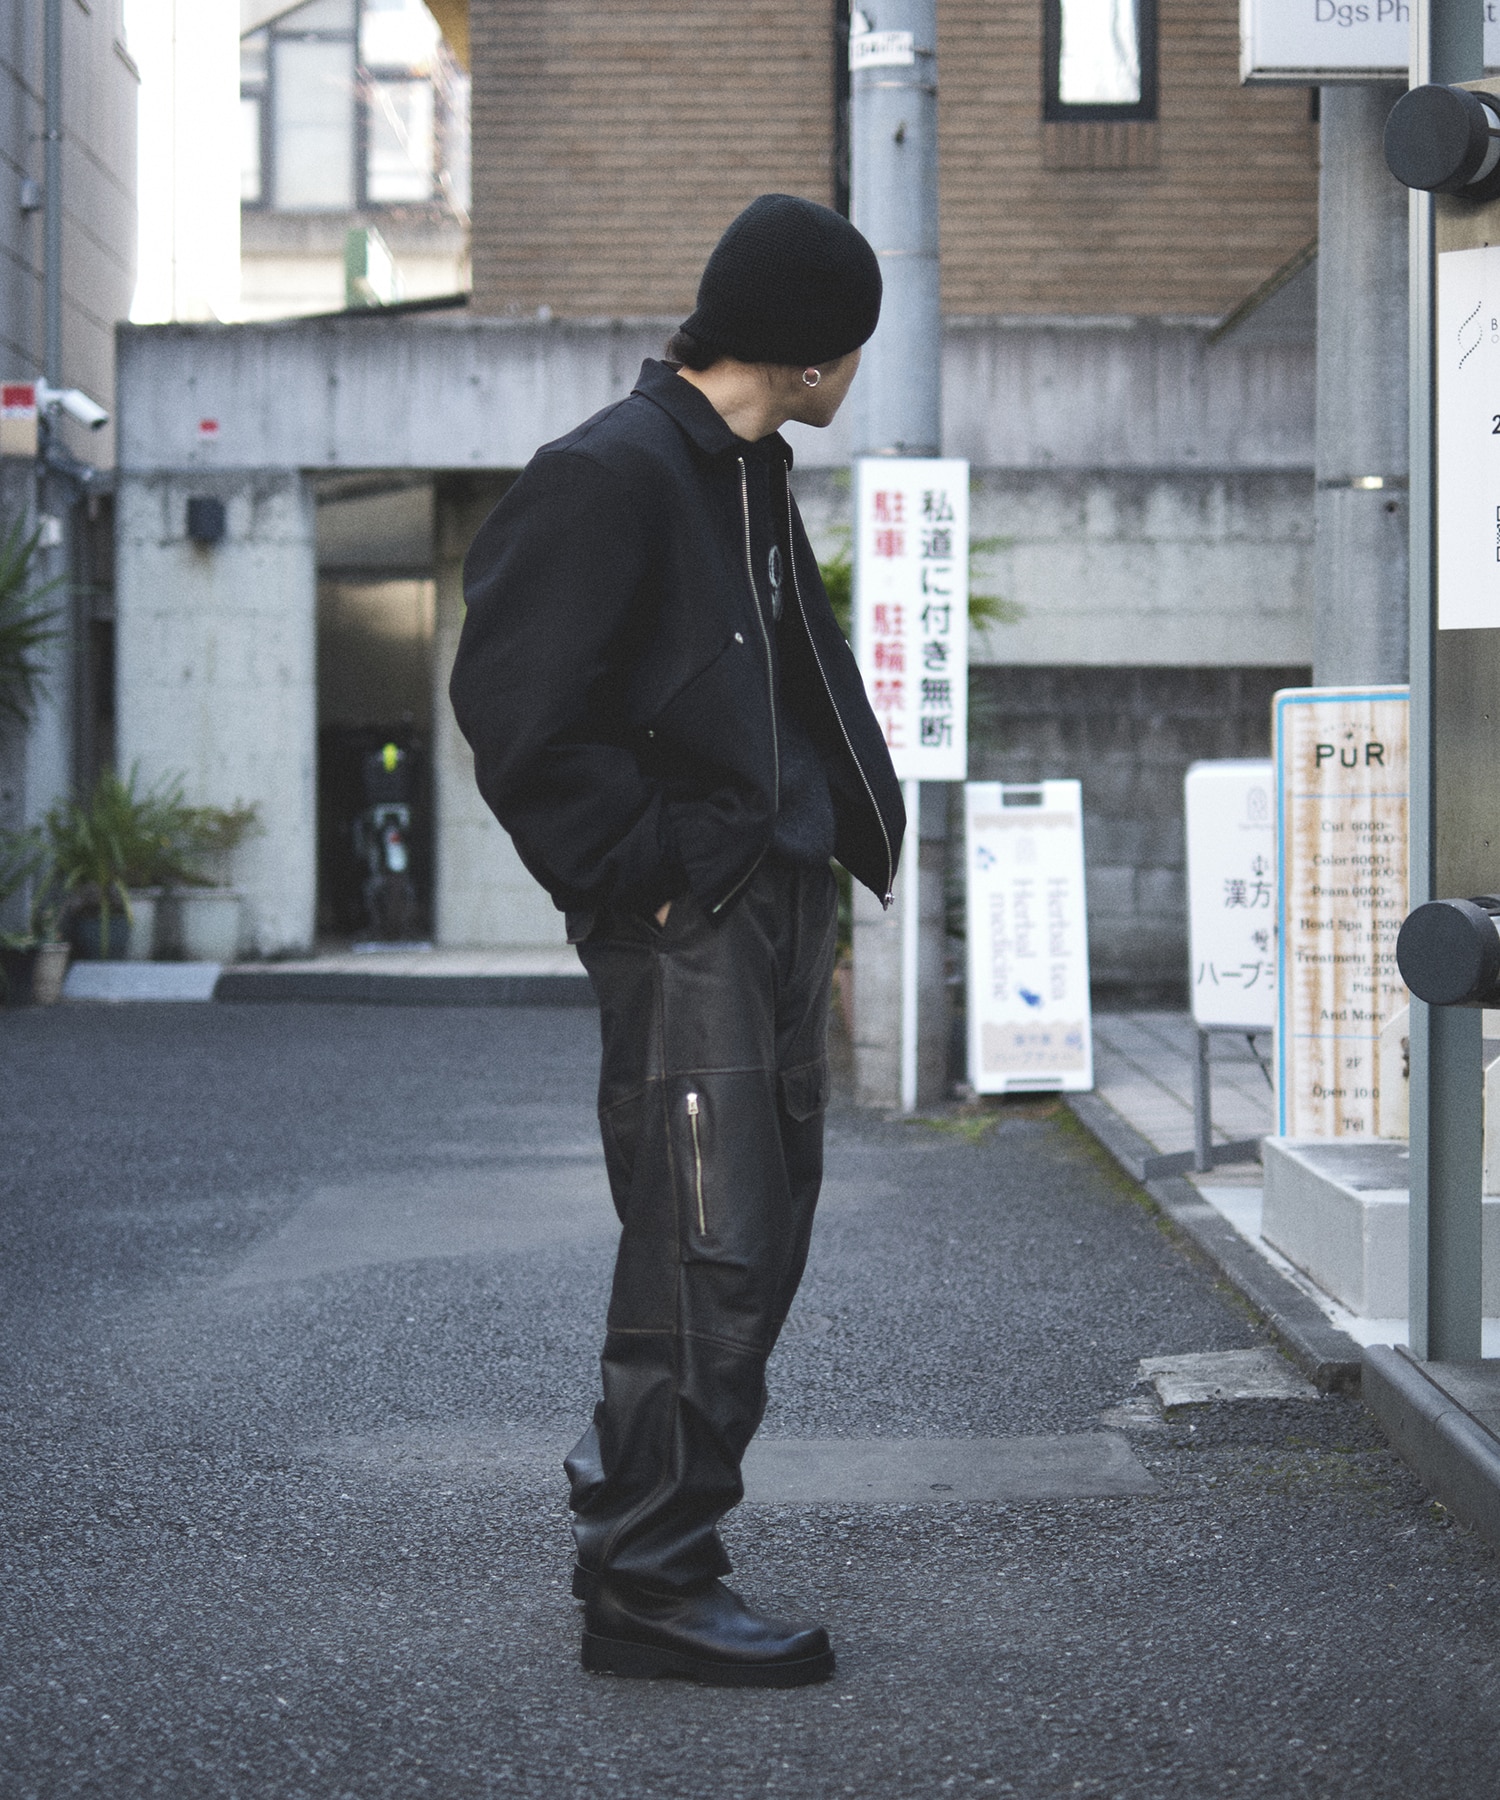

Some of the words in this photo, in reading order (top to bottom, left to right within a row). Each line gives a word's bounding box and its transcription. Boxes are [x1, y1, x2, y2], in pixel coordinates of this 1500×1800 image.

[1315, 0, 1370, 27] Dgs
[920, 490, 955, 748] 私道に付き無断
[1321, 820, 1344, 832] Cut
[1312, 854, 1348, 866] Color
[1223, 879, 1273, 909] 漢方
[1300, 919, 1333, 930] Head
[1337, 919, 1362, 932] Spa
[1296, 951, 1366, 963] Treatment
[1373, 953, 1397, 963] 200
[1320, 1009, 1347, 1021] And
[1352, 1009, 1386, 1021] More
[1345, 1057, 1362, 1069] 2F
[1312, 1083, 1347, 1100] Open
[1342, 1118, 1364, 1132] Tel
